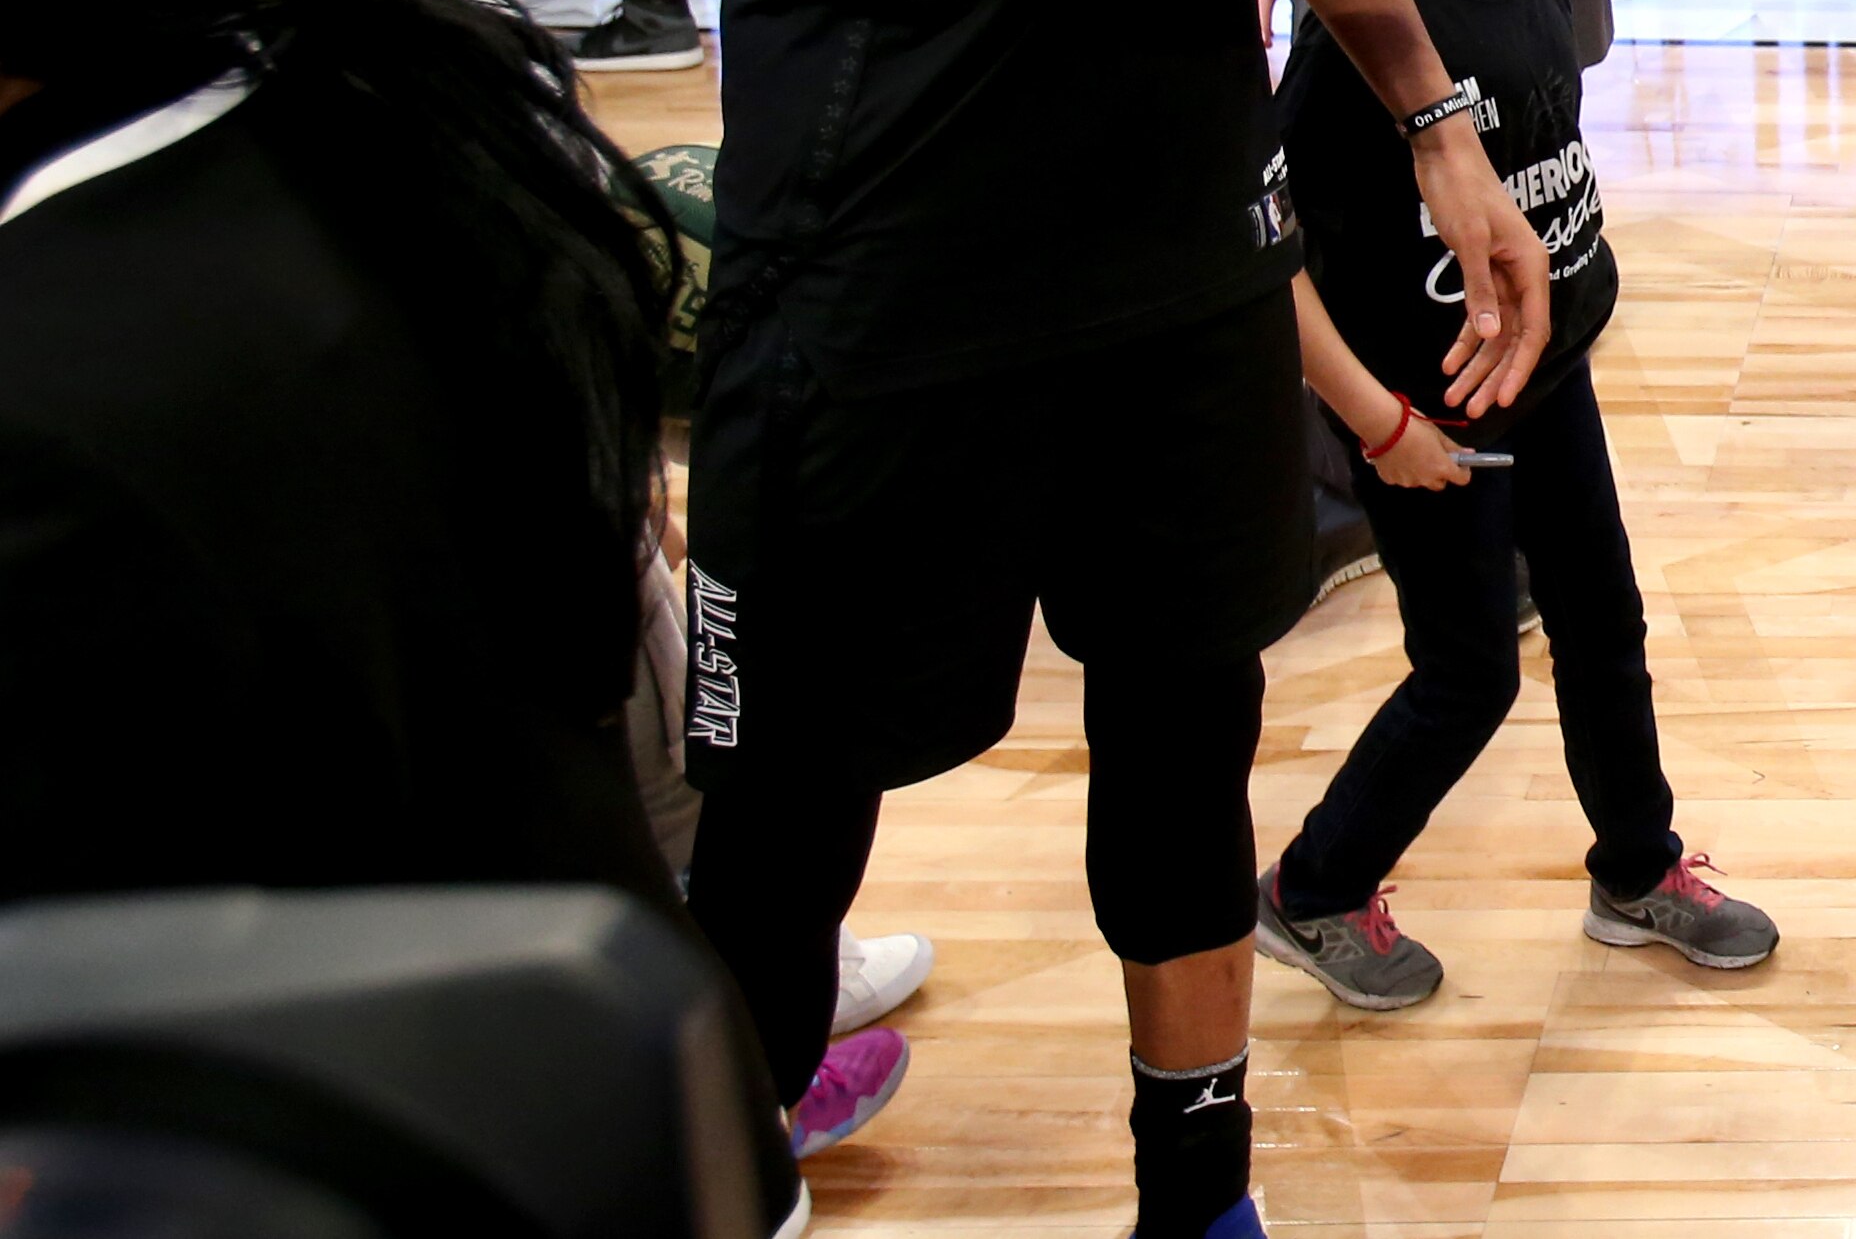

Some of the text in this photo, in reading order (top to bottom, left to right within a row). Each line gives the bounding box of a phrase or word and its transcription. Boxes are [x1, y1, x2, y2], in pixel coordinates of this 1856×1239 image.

[1414, 114, 1434, 128] On
[1435, 108, 1444, 119] a
[687, 558, 741, 748] ALL-STAR
